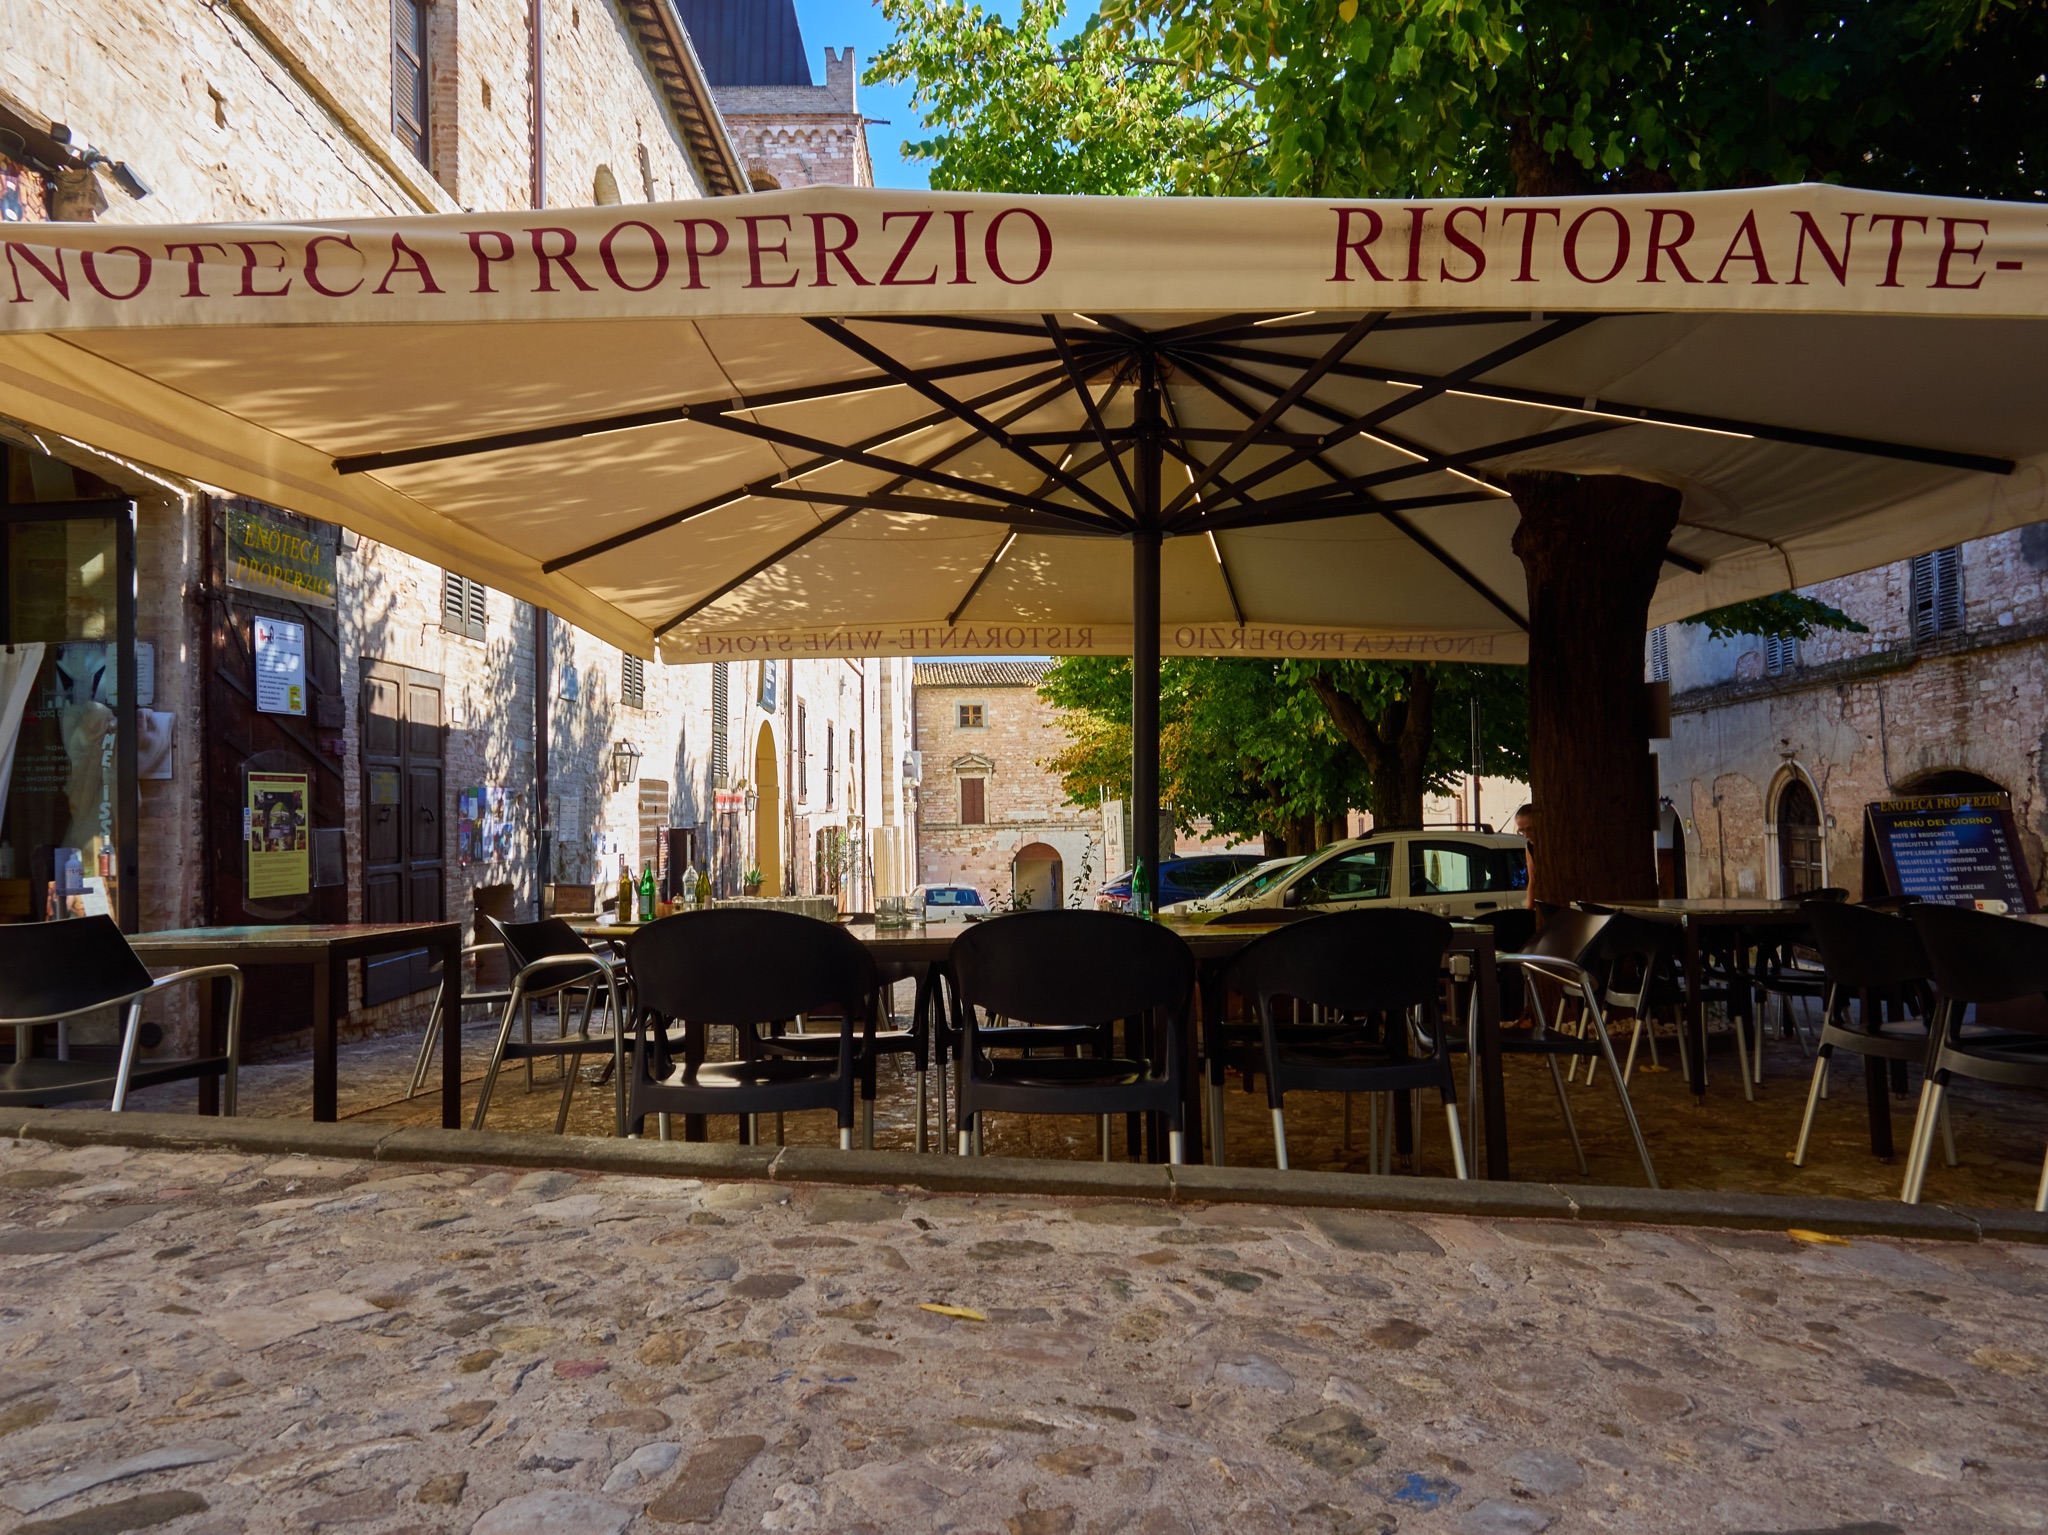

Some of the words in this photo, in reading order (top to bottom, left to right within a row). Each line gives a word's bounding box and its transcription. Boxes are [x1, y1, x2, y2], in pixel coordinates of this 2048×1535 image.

[459, 207, 1054, 295] PROPERZIO
[243, 522, 321, 566] ENOTECA
[234, 555, 330, 598] PROPERZIO
[1880, 798, 1934, 812] ENOTECA
[1937, 795, 2001, 809] PROPERZIO
[1893, 817, 1925, 828] MENÙ
[1927, 818, 1948, 827] DEL
[1950, 816, 1993, 826] GIORNO
[1890, 832, 1909, 840] MISTO
[1918, 830, 1956, 839] BRUSCHETTE
[1892, 840, 1929, 848] PROSCIUTTO
[1935, 839, 1960, 847] MELONE
[1897, 858, 1934, 866] TAGLIATELLE
[1943, 856, 1978, 864] POMODORO
[1899, 867, 1936, 875] TAGLIATELLE
[1901, 876, 1929, 884] LASAGNE
[1903, 884, 1941, 892] PARMIGIANA
[1950, 883, 1986, 891] MELANZANE
